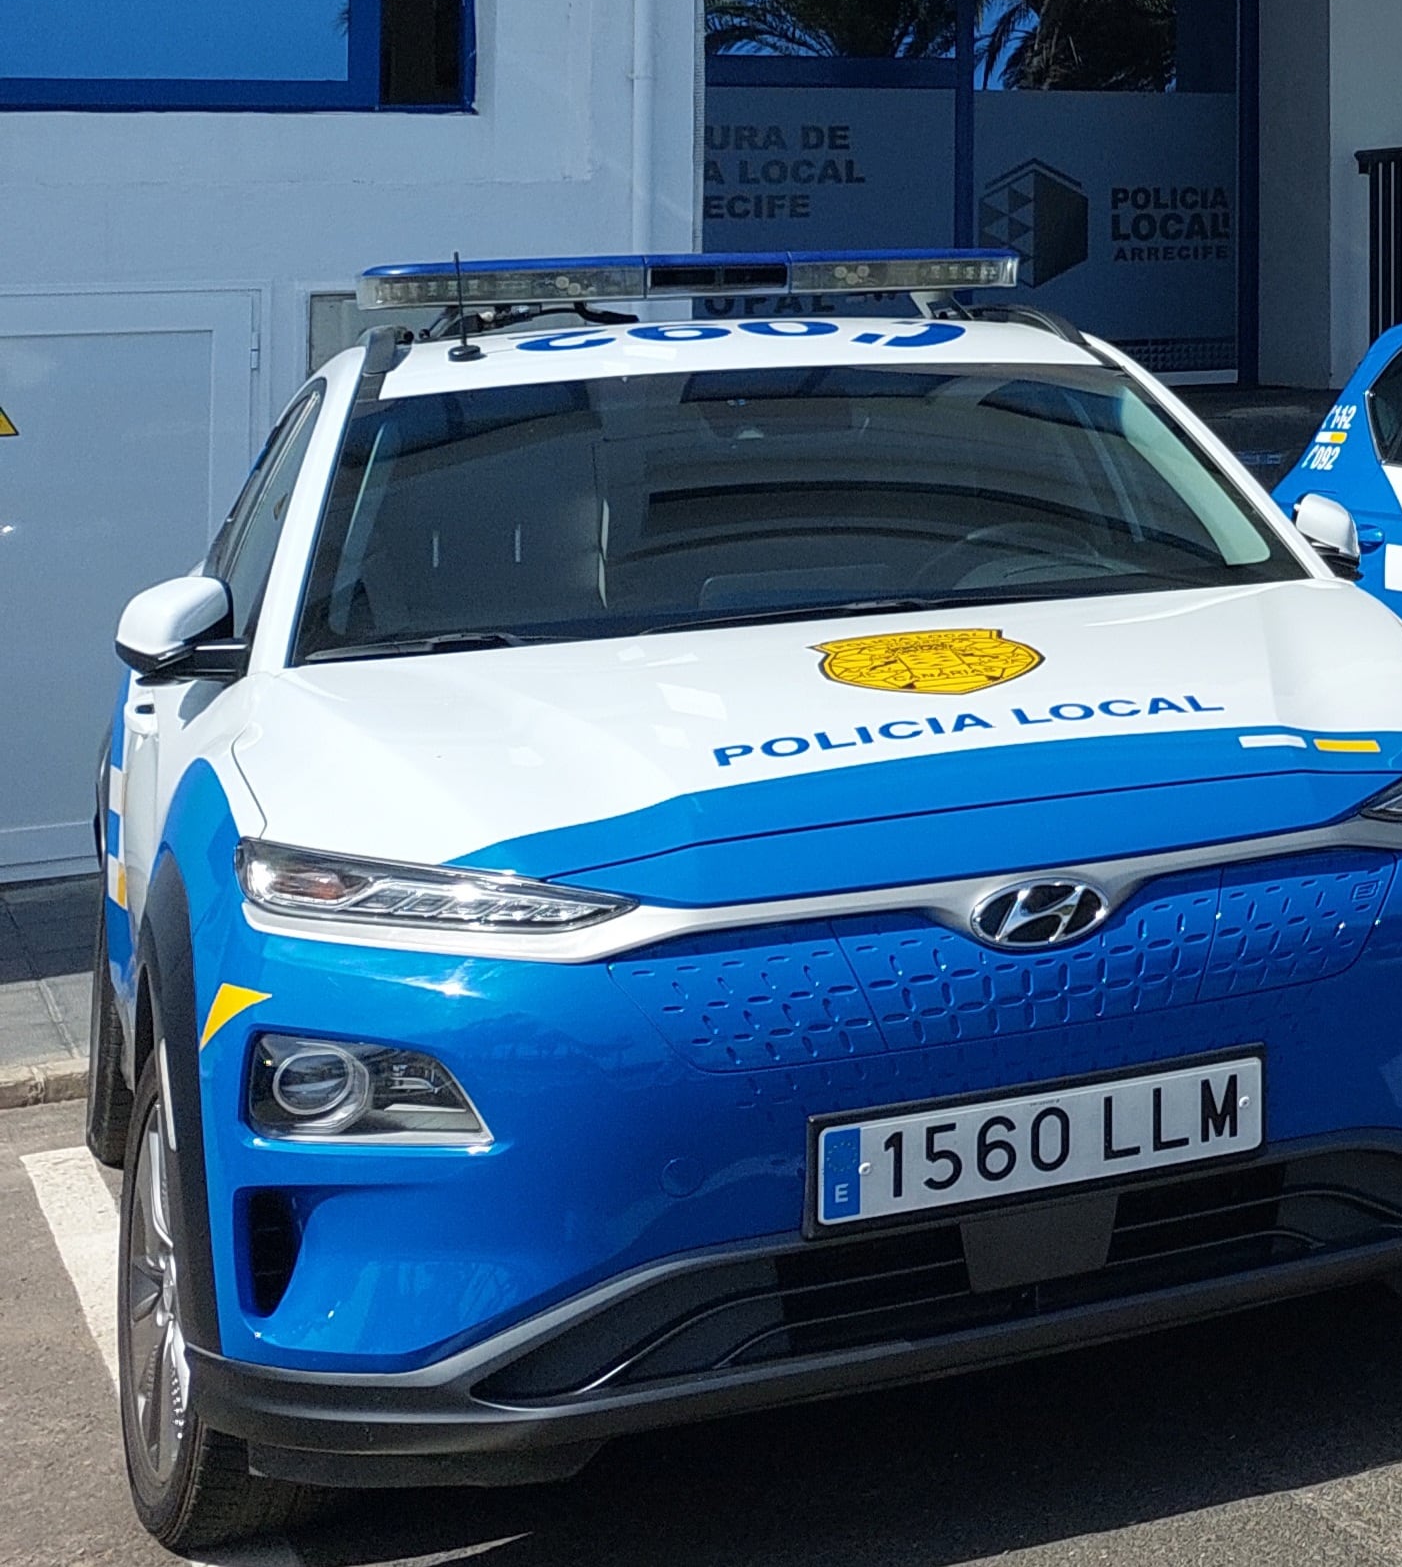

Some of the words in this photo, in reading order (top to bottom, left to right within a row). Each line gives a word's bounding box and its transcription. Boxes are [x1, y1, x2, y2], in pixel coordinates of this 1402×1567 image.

[801, 124, 850, 150] DE
[739, 159, 866, 184] LOCAL
[1111, 186, 1229, 210] POLICIA
[1111, 212, 1230, 241] LOCAL
[1114, 243, 1230, 262] ARRECIFE
[1309, 446, 1341, 471] 092
[713, 713, 996, 767] POLICIA
[1011, 695, 1225, 725] LOCAL
[884, 1106, 1070, 1198] 1560
[1103, 1074, 1238, 1161] LLM
[834, 1184, 849, 1203] E
